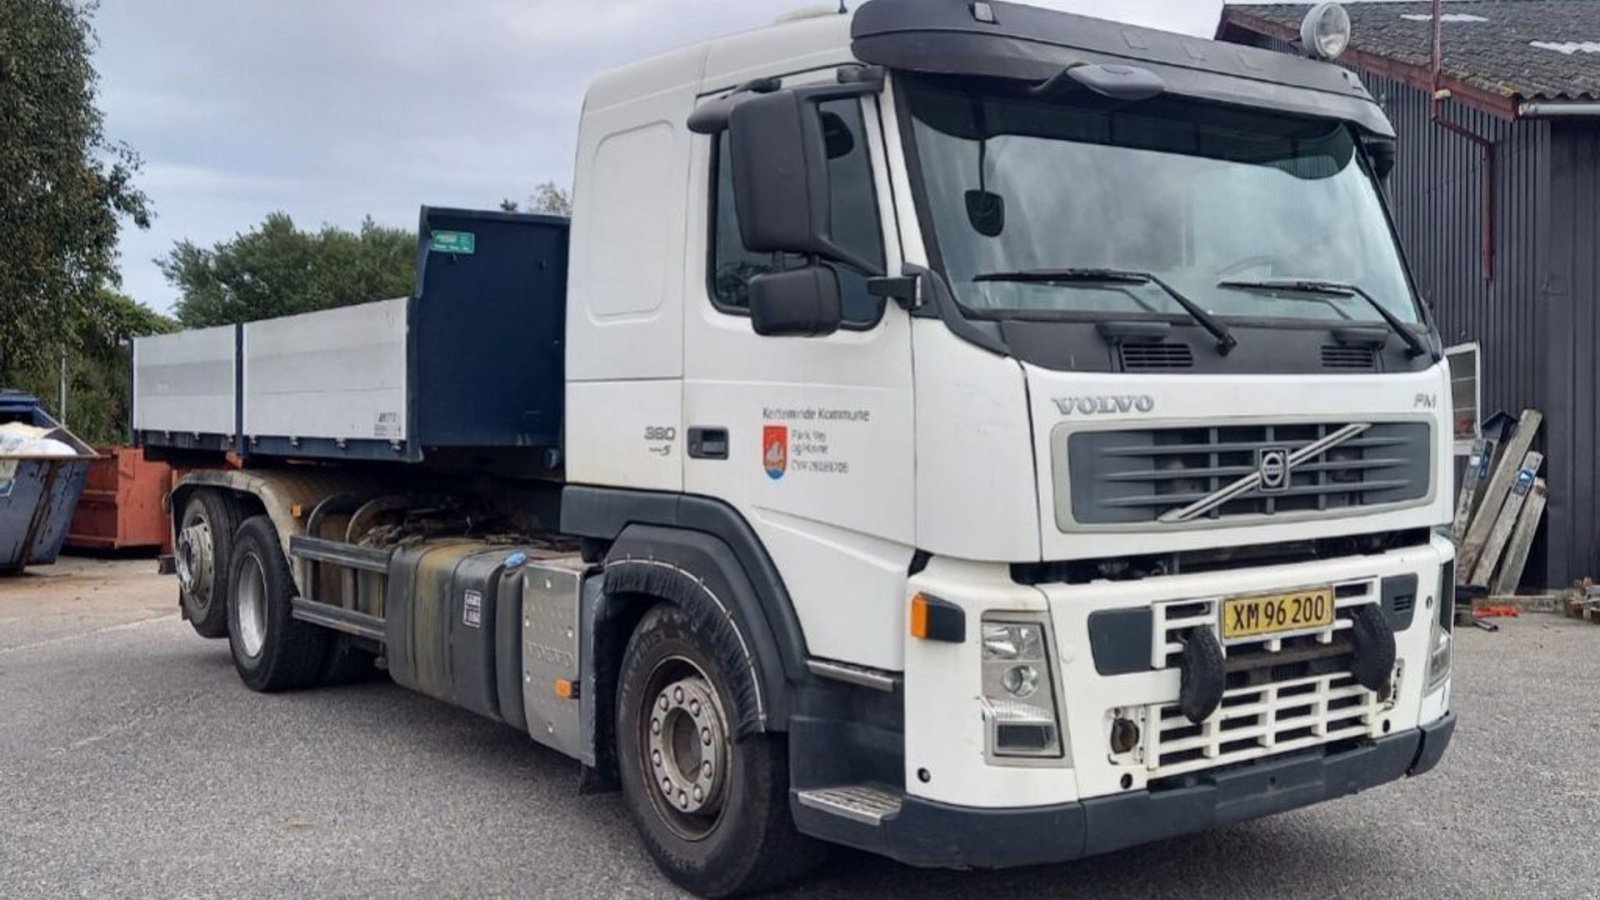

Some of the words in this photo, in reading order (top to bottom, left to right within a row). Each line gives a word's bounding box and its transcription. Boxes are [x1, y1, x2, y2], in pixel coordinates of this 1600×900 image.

[1050, 394, 1155, 416] VOLVO
[1413, 392, 1437, 408] FM
[763, 407, 816, 420] Kerteminde
[818, 408, 870, 422] Kommune
[644, 426, 676, 441] 380
[1232, 603, 1259, 631] XM
[1264, 600, 1287, 628] 96
[1291, 594, 1325, 623] 200
